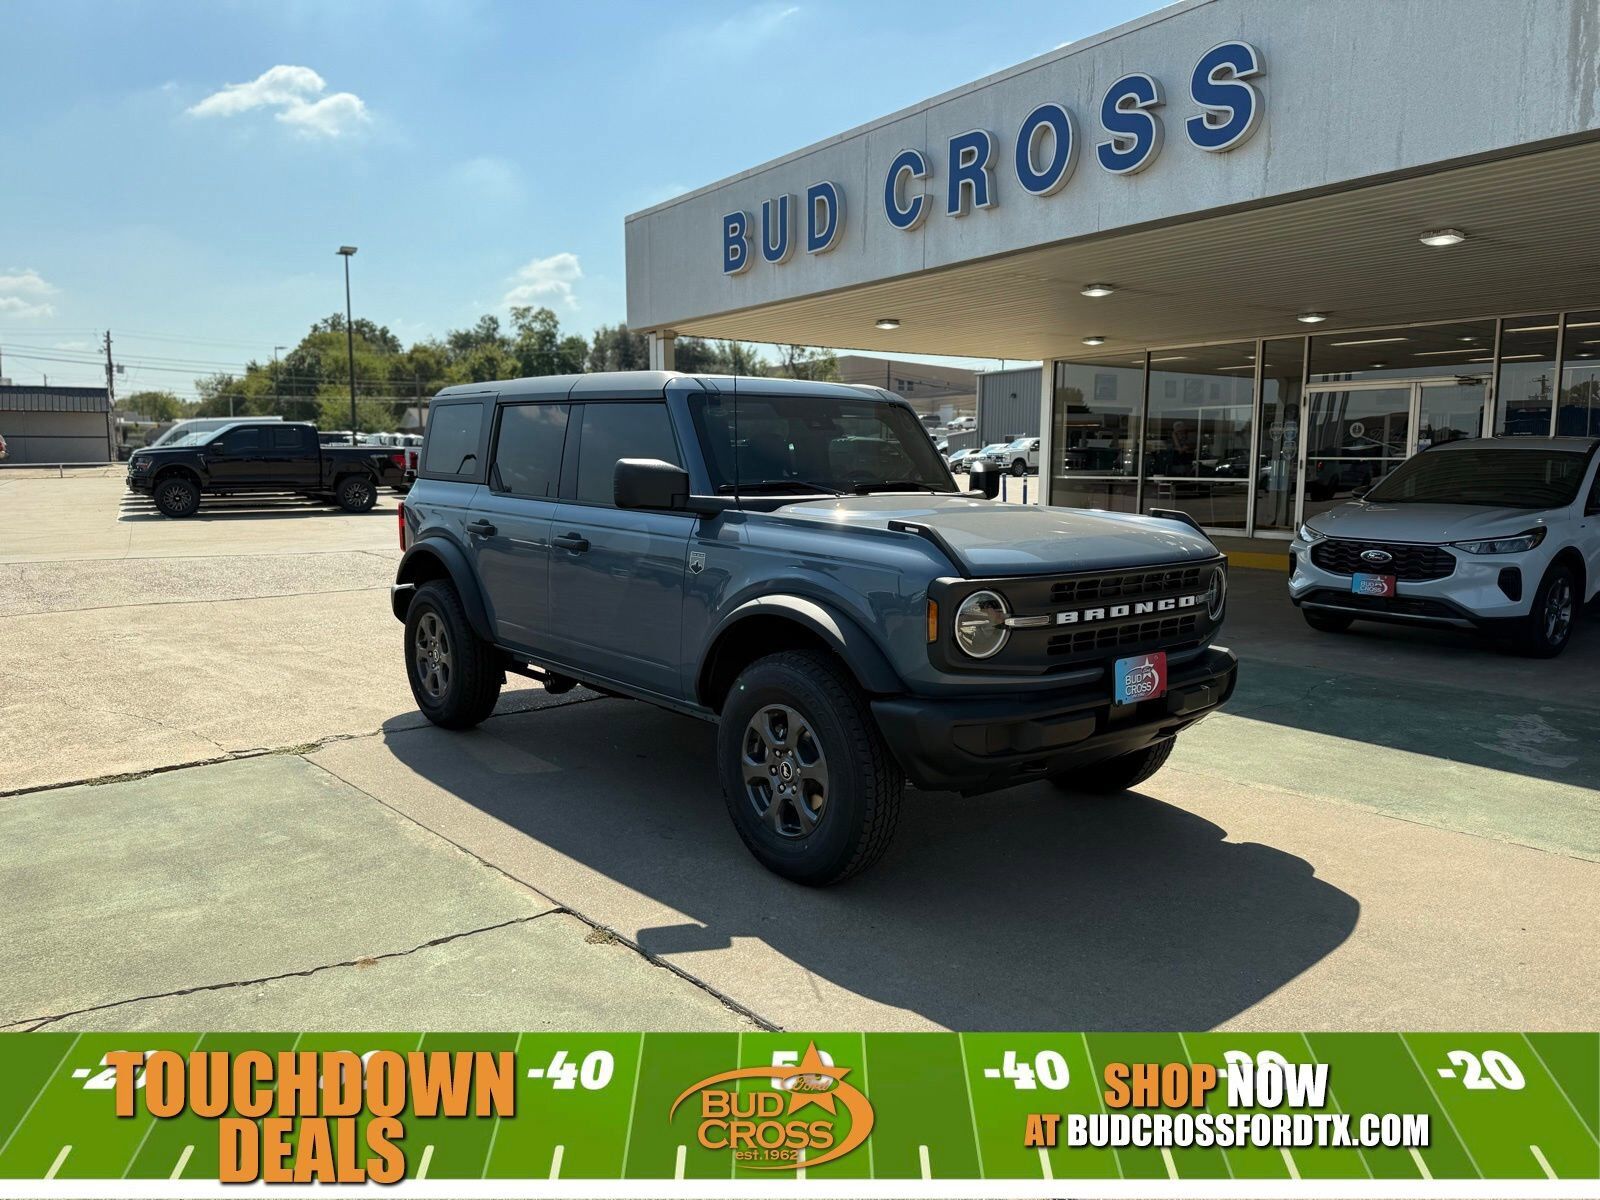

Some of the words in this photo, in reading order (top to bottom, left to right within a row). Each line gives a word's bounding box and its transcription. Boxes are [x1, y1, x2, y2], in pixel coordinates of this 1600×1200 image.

[723, 179, 847, 276] BUD
[883, 39, 1266, 231] CROSS
[1359, 585, 1382, 593] CROSS
[1056, 595, 1196, 625] BRONCO
[1125, 674, 1142, 686] BUD
[1125, 681, 1152, 696] CROSS
